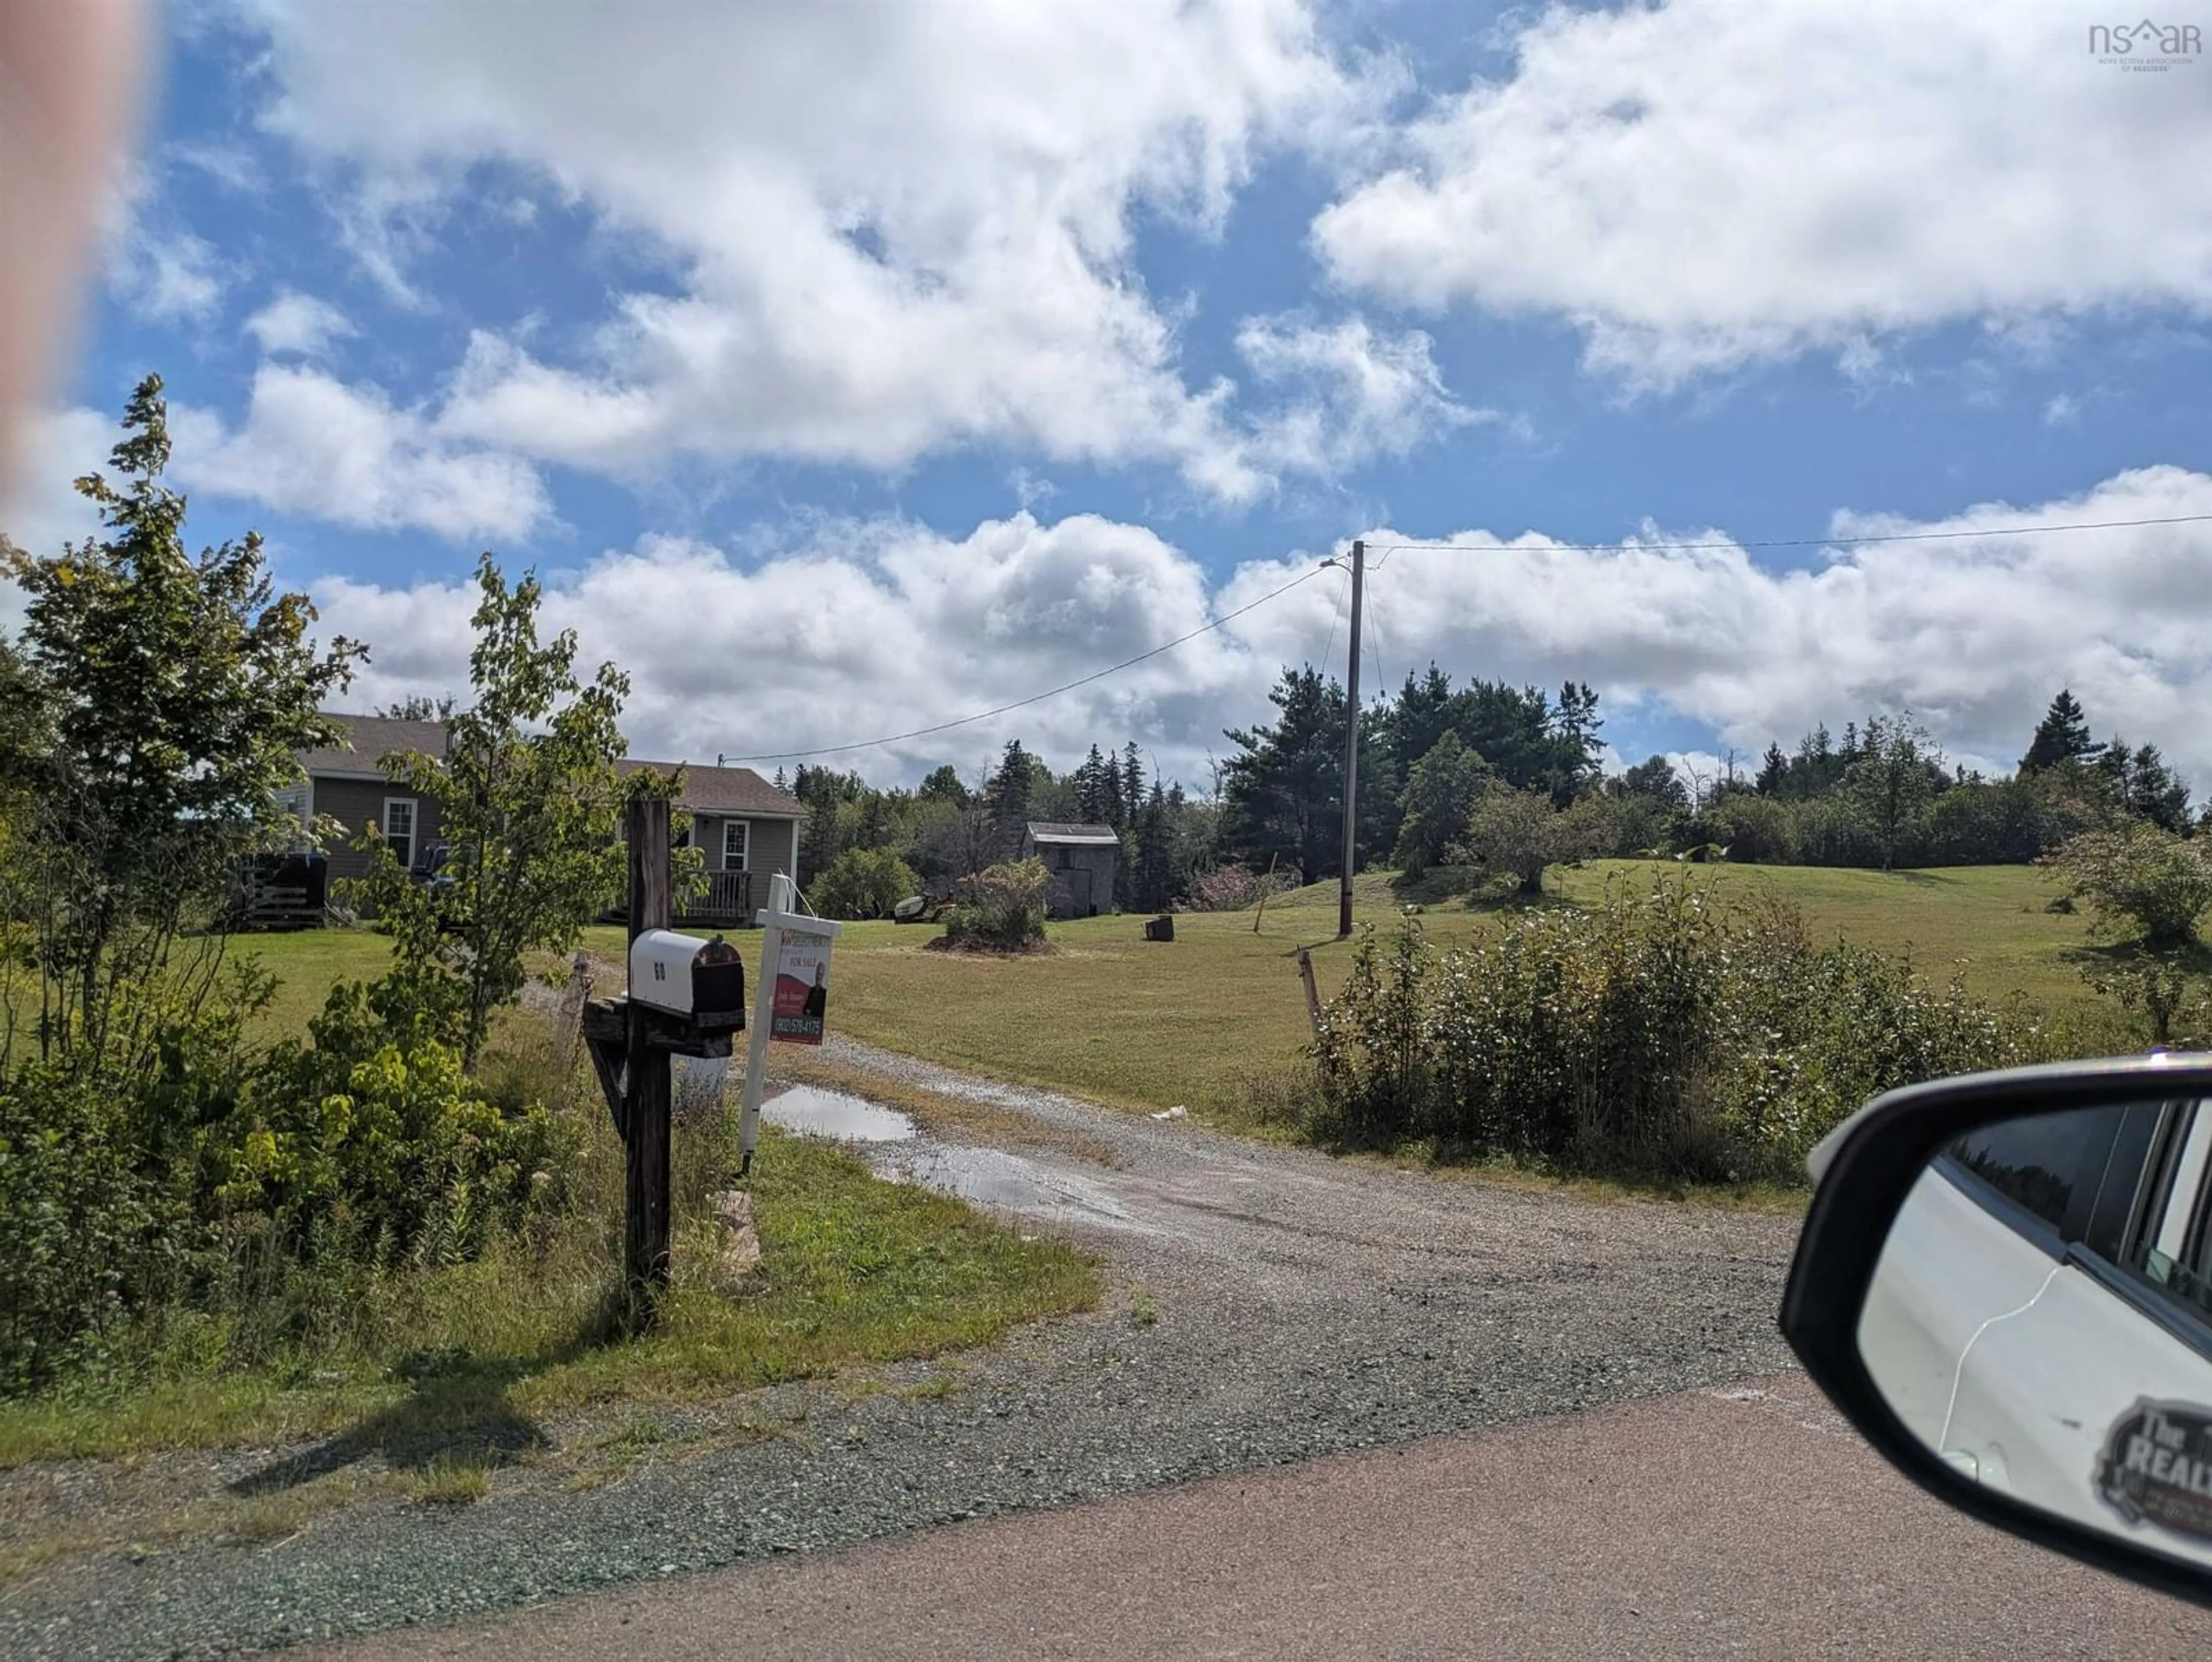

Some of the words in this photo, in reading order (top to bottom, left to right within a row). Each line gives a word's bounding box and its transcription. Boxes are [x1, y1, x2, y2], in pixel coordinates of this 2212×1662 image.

[789, 956, 801, 967] FOR
[801, 956, 817, 967] SALE
[2141, 1411, 2186, 1450] The
